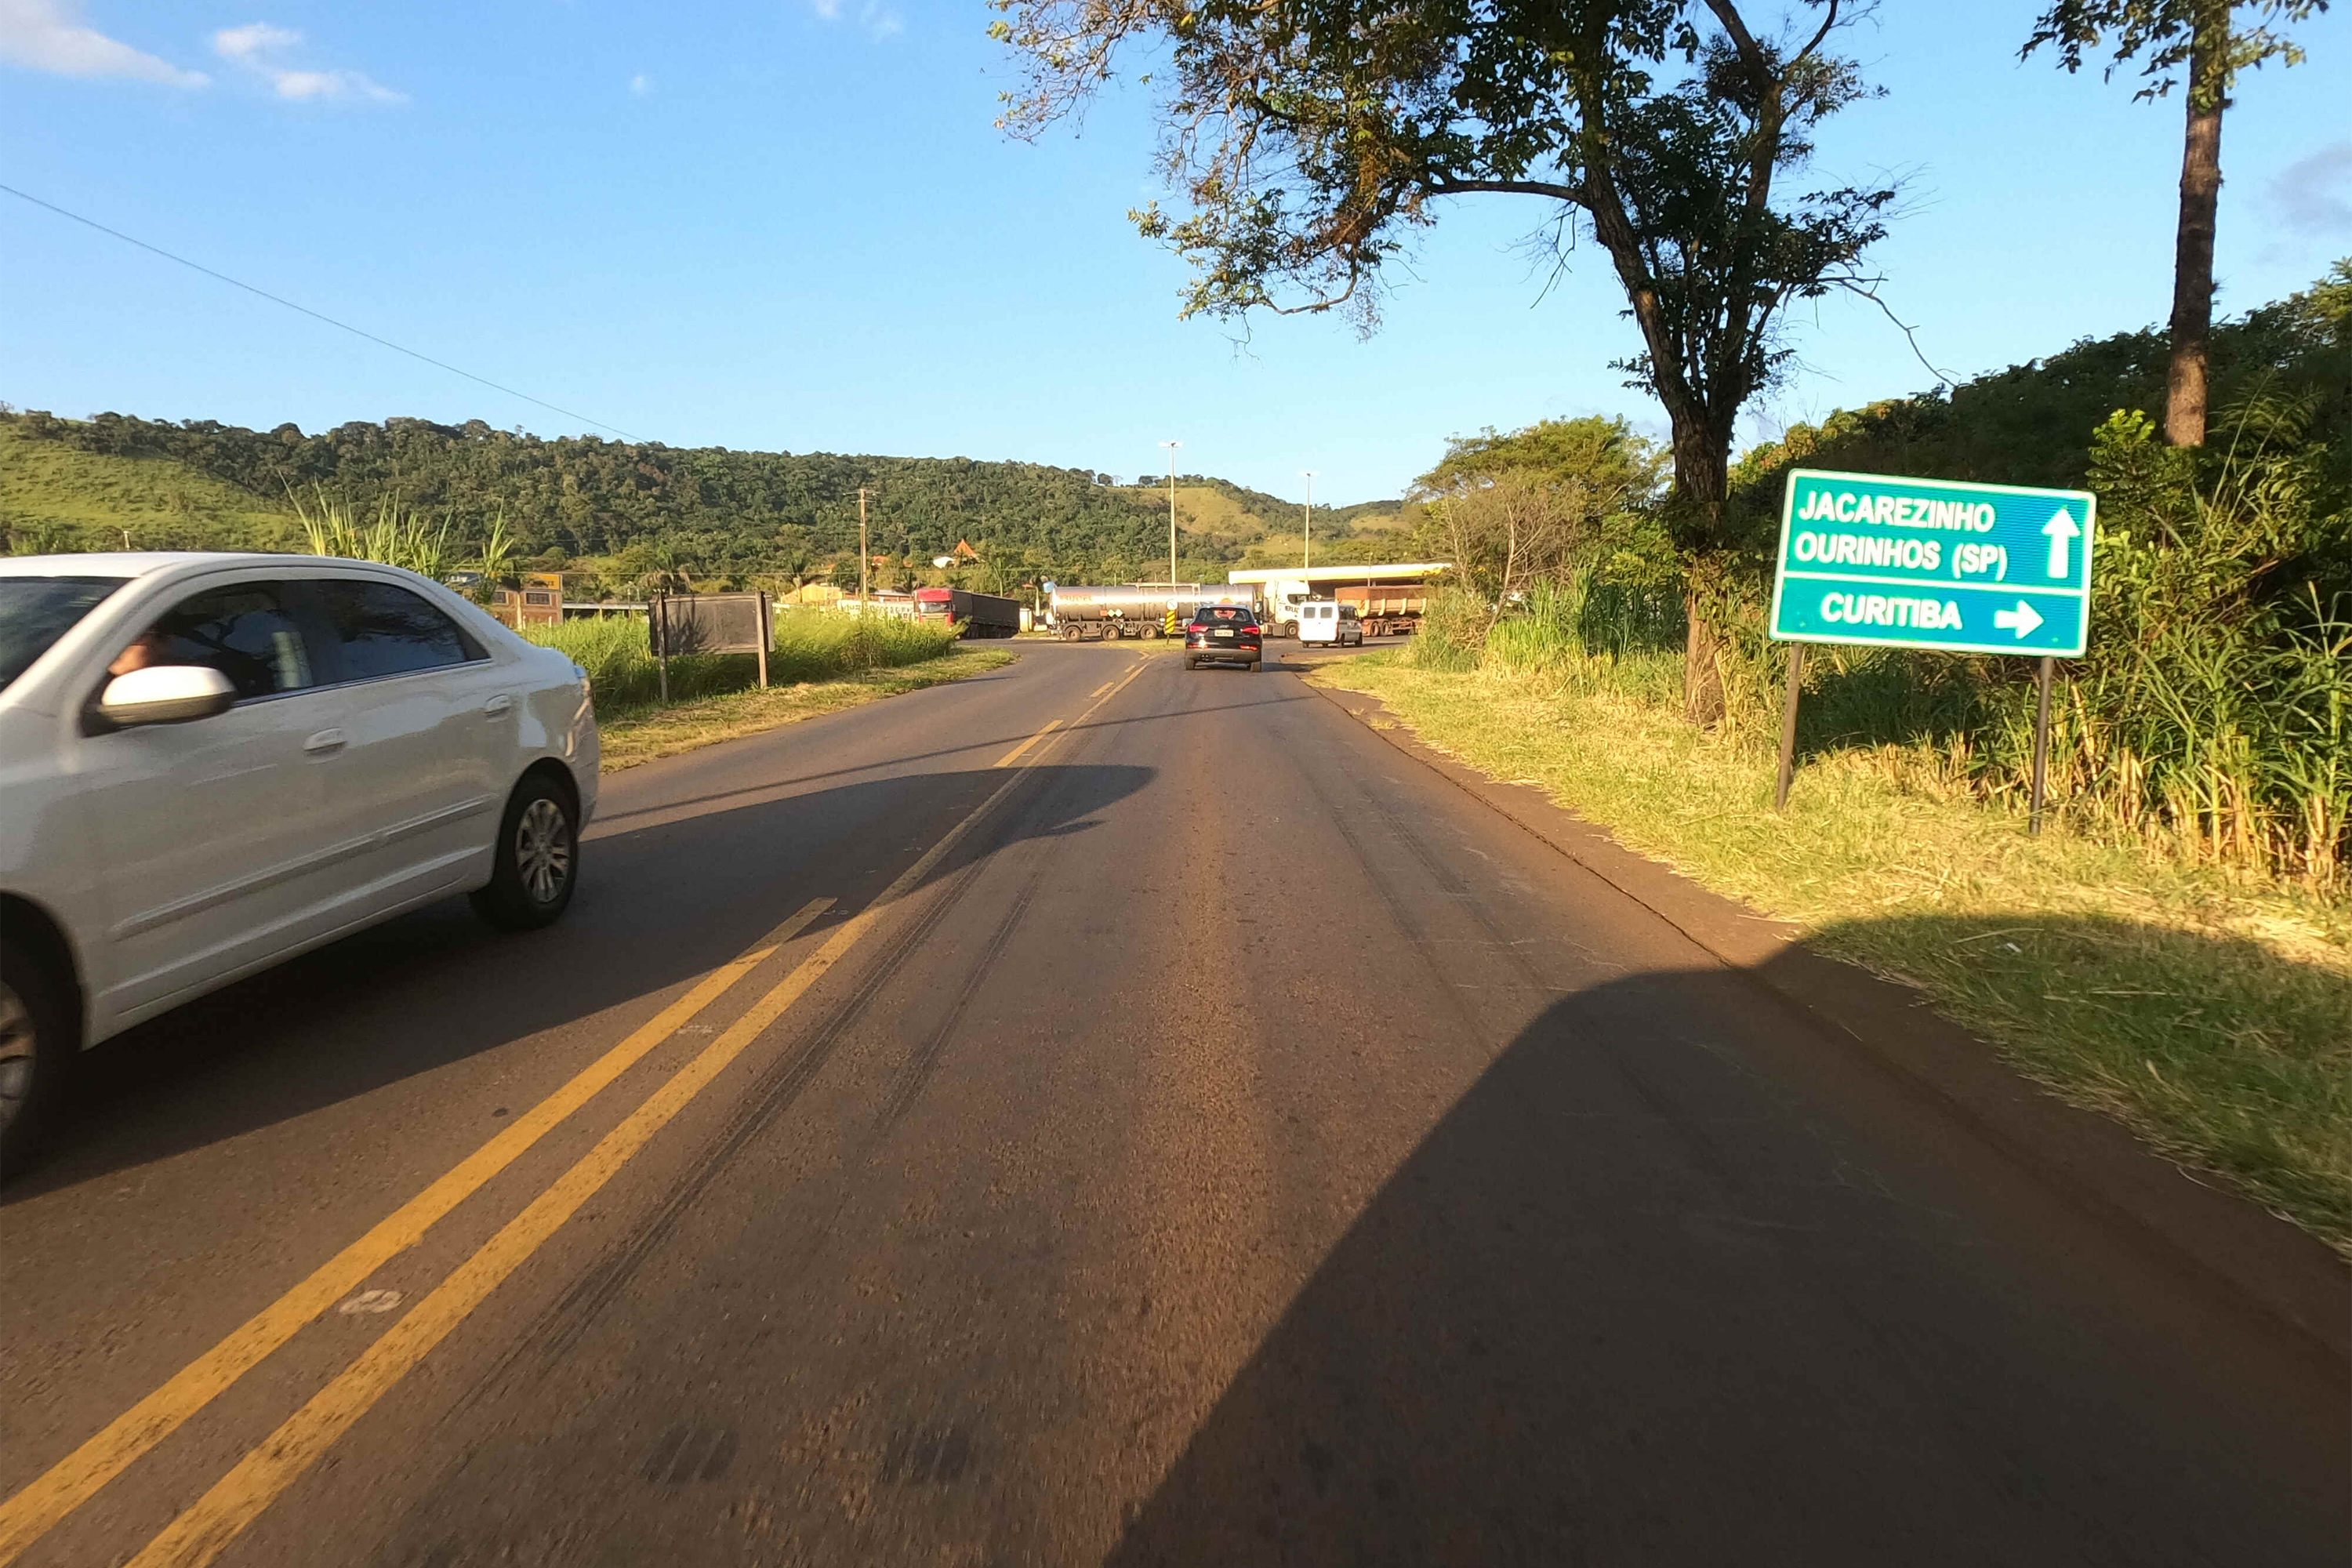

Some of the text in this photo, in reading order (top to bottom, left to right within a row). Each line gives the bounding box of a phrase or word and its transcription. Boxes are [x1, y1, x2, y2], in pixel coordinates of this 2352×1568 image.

[1799, 491, 1994, 532] JACAREZINHO
[1795, 532, 2007, 581] OURINHOS (SP)
[1821, 593, 1962, 630] CURITIBA
